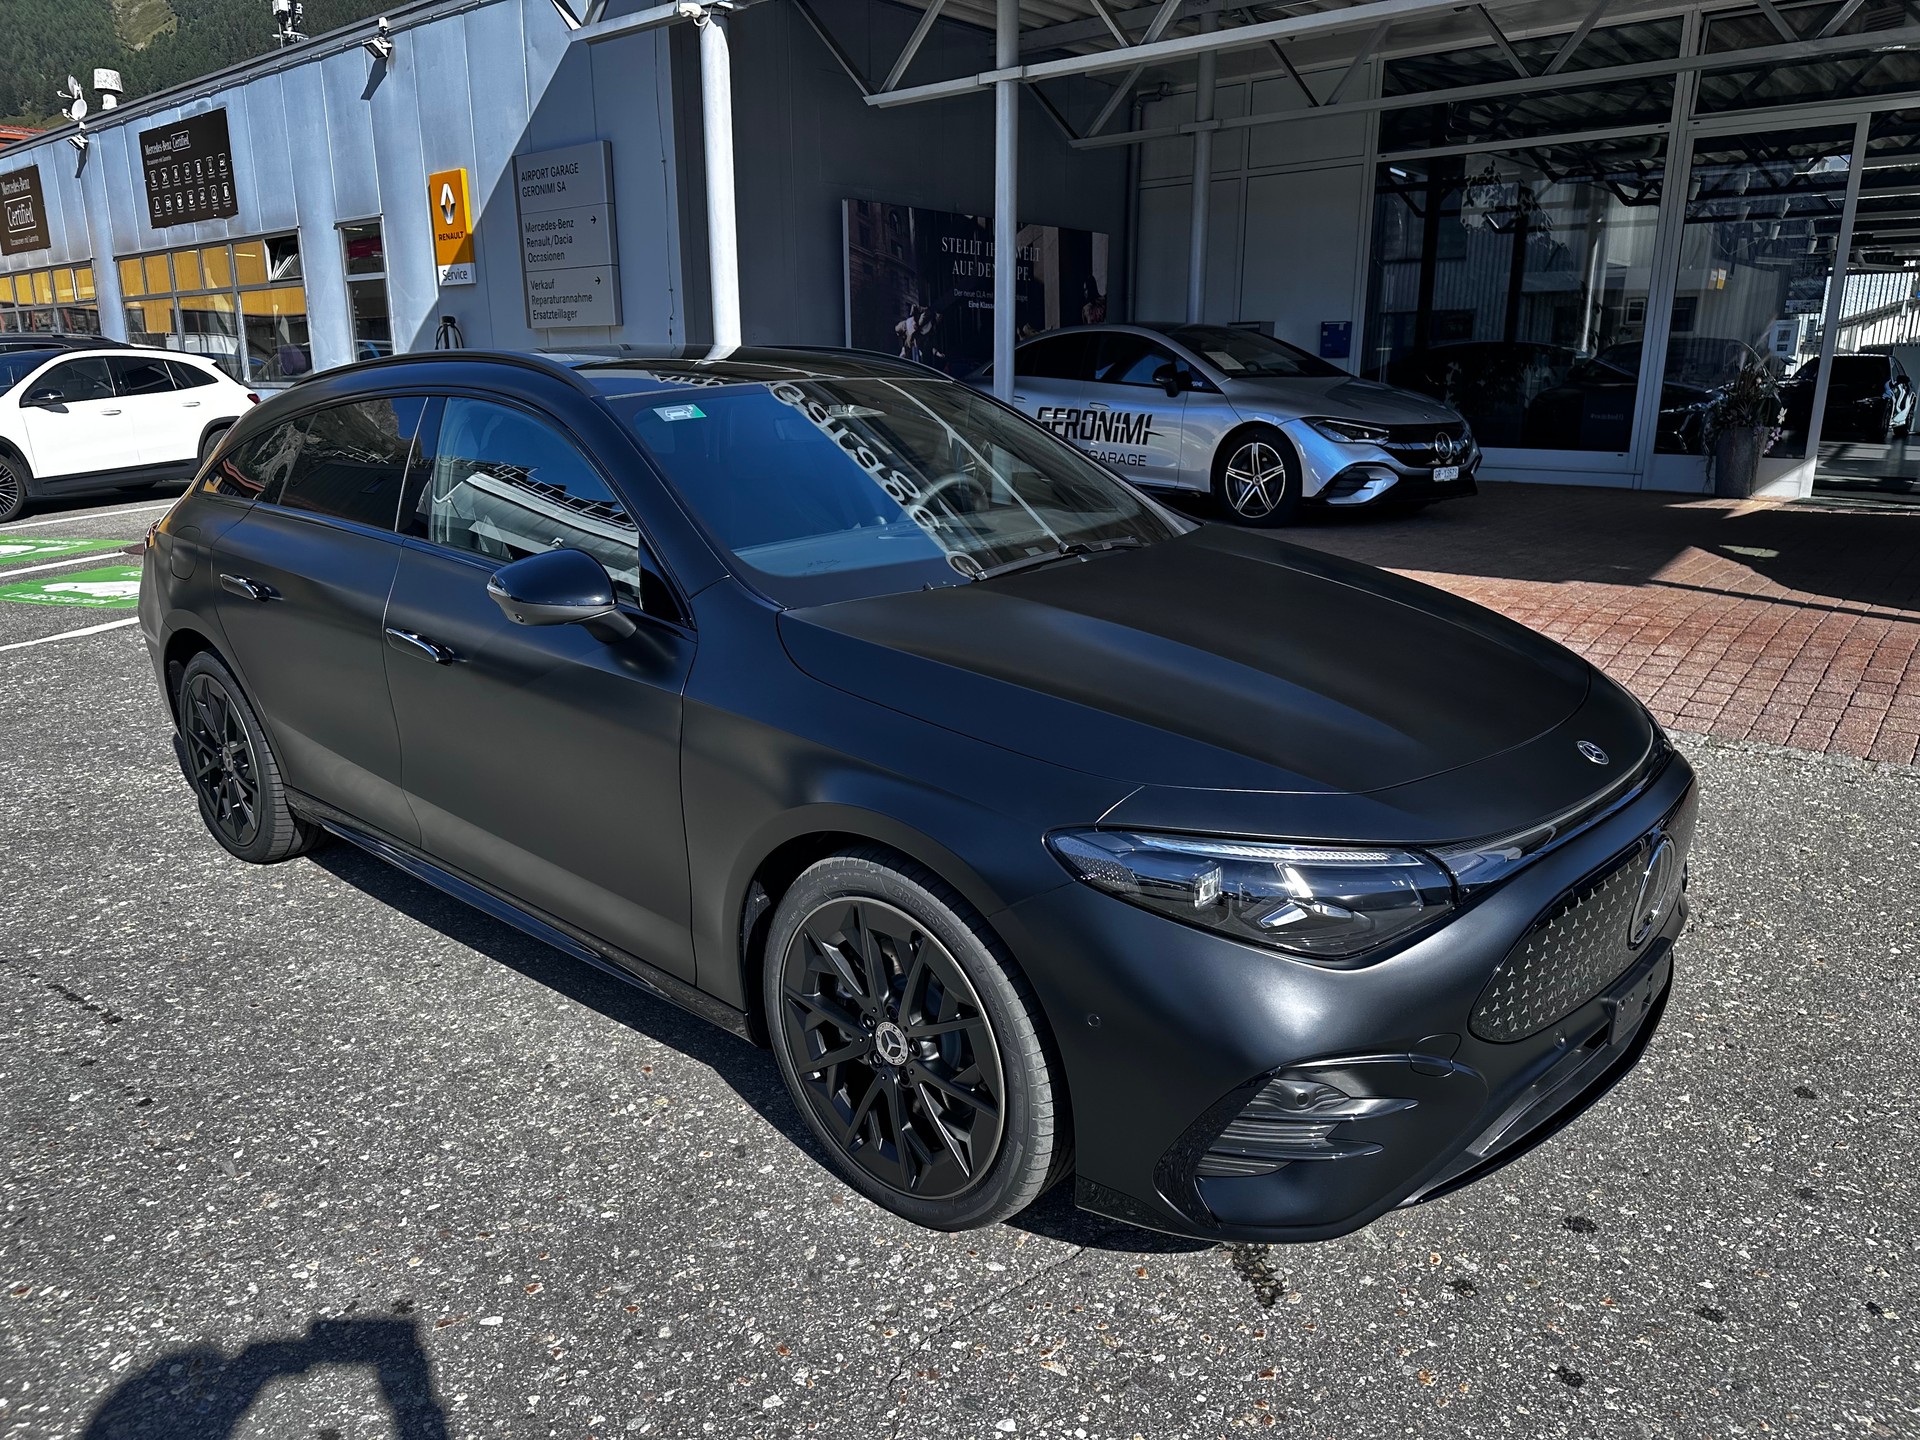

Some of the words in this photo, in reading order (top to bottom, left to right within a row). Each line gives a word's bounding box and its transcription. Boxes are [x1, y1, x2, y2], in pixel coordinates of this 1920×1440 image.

[521, 167, 549, 182] AIRPORT
[550, 162, 579, 178] GARAGE
[522, 182, 556, 198] GERONIMI
[557, 181, 567, 193] SA
[7, 201, 34, 227] Certified
[525, 218, 574, 233] Mercedes-Benz
[438, 230, 464, 241] RENAULT
[941, 236, 982, 256] STELLT
[527, 251, 565, 263] Occasionen
[442, 268, 468, 281] Service
[952, 260, 974, 276] AUF
[530, 278, 555, 291] Verkauf
[531, 293, 593, 307] Reparaturannahme
[968, 300, 980, 309] Eine
[533, 308, 578, 321] Ersatzteillager
